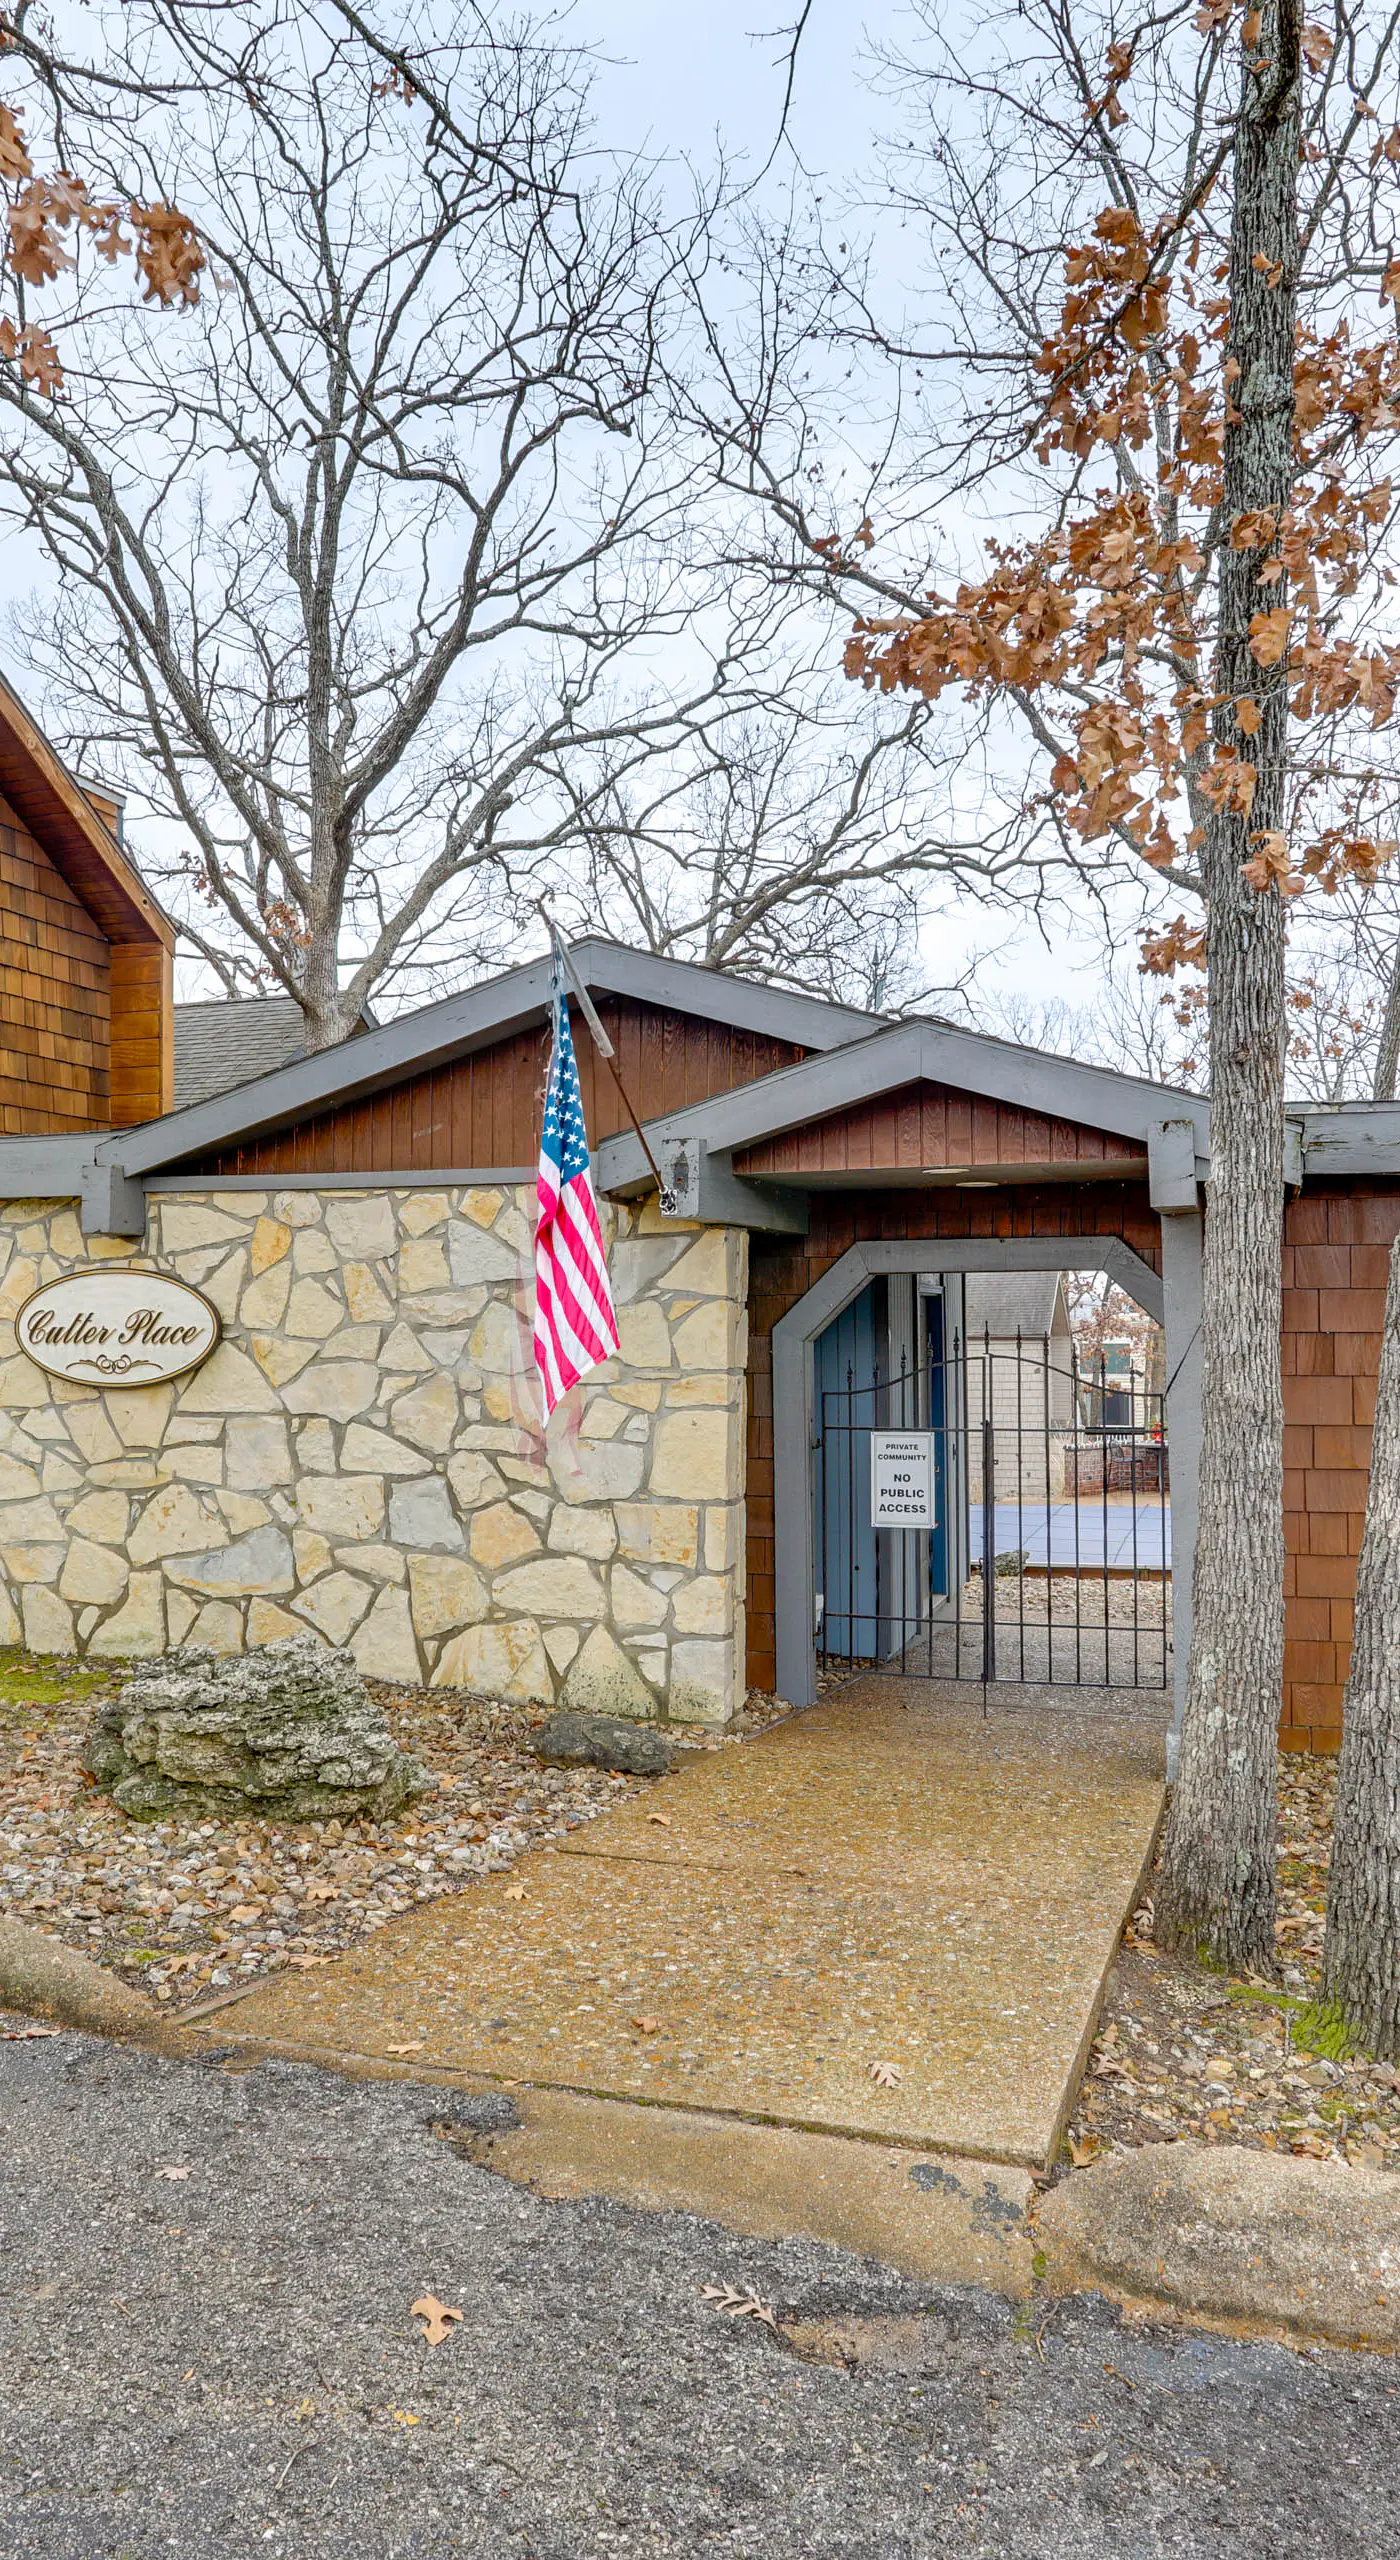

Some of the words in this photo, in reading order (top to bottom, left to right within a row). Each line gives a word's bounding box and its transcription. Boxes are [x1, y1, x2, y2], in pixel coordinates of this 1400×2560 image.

[27, 1308, 118, 1345] Cutter
[118, 1308, 204, 1345] Place
[885, 1443, 919, 1451] PRIVATE
[893, 1473, 911, 1483] NO
[880, 1488, 925, 1498] PUBLIC
[879, 1503, 927, 1514] ACCESS
